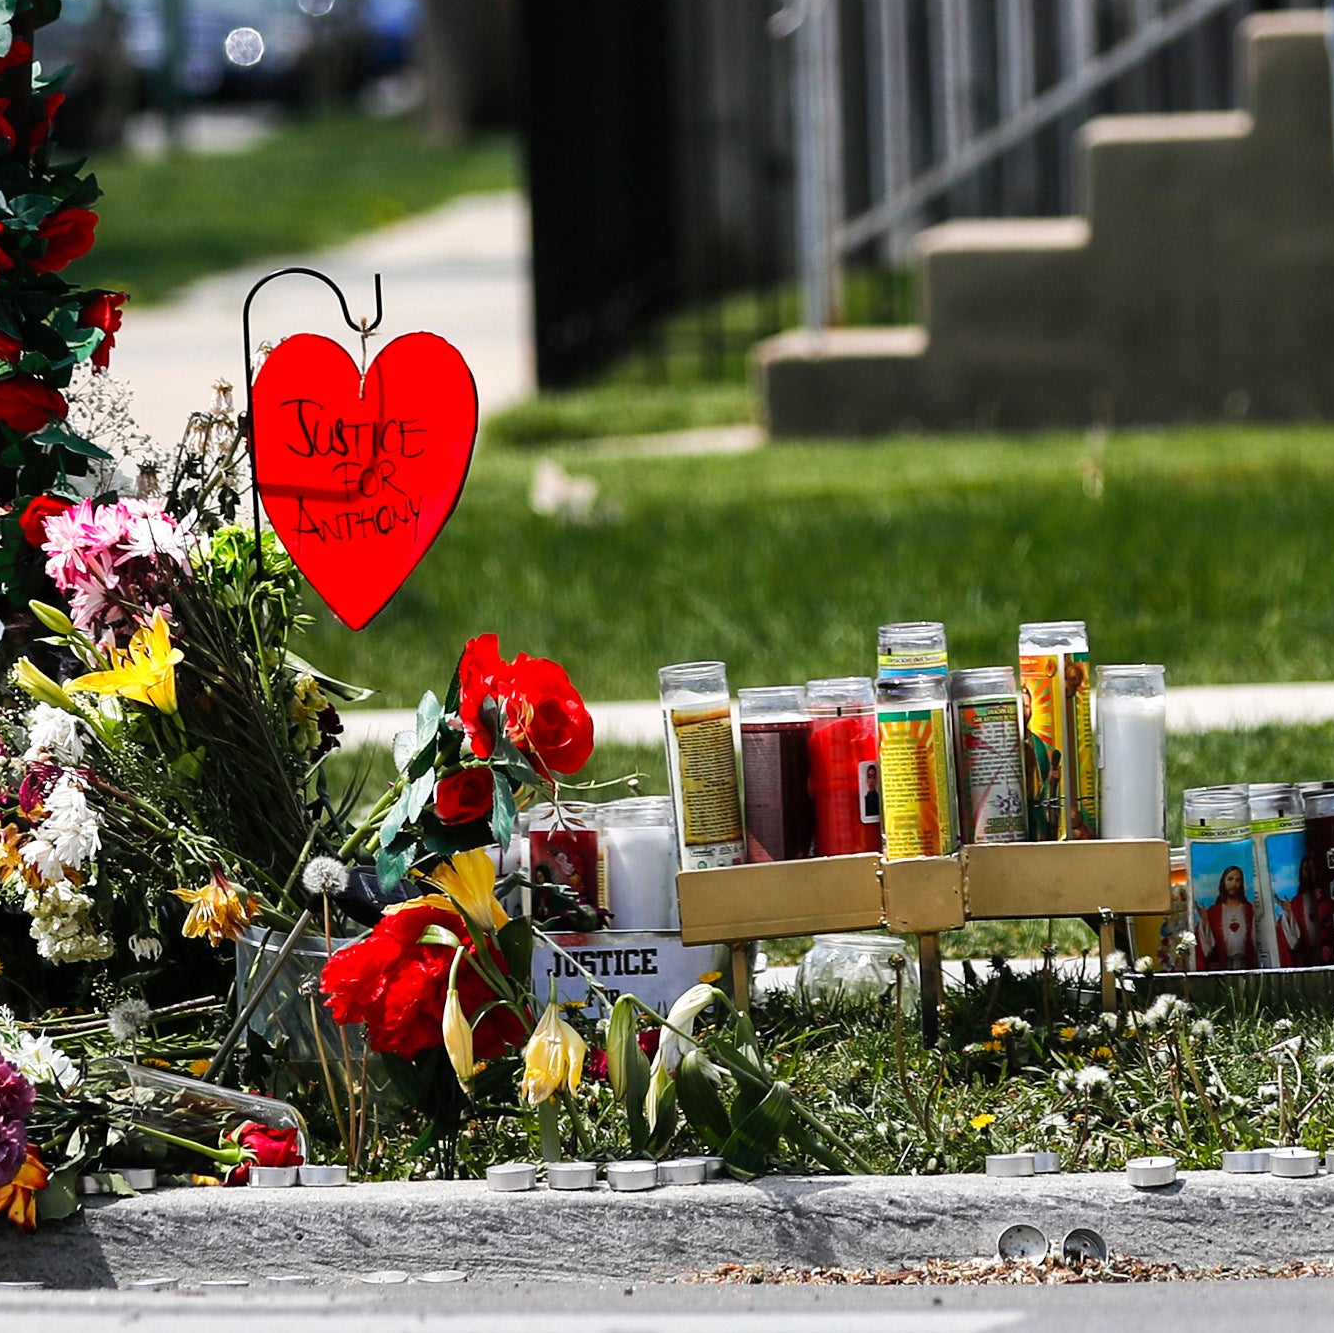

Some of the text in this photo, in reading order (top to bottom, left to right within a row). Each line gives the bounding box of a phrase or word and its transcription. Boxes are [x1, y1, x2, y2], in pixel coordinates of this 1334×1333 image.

[280, 398, 427, 459] JUSTICE
[331, 460, 407, 500] FOR
[291, 496, 424, 556] ANTHONY
[545, 948, 658, 978] JUSTICE
